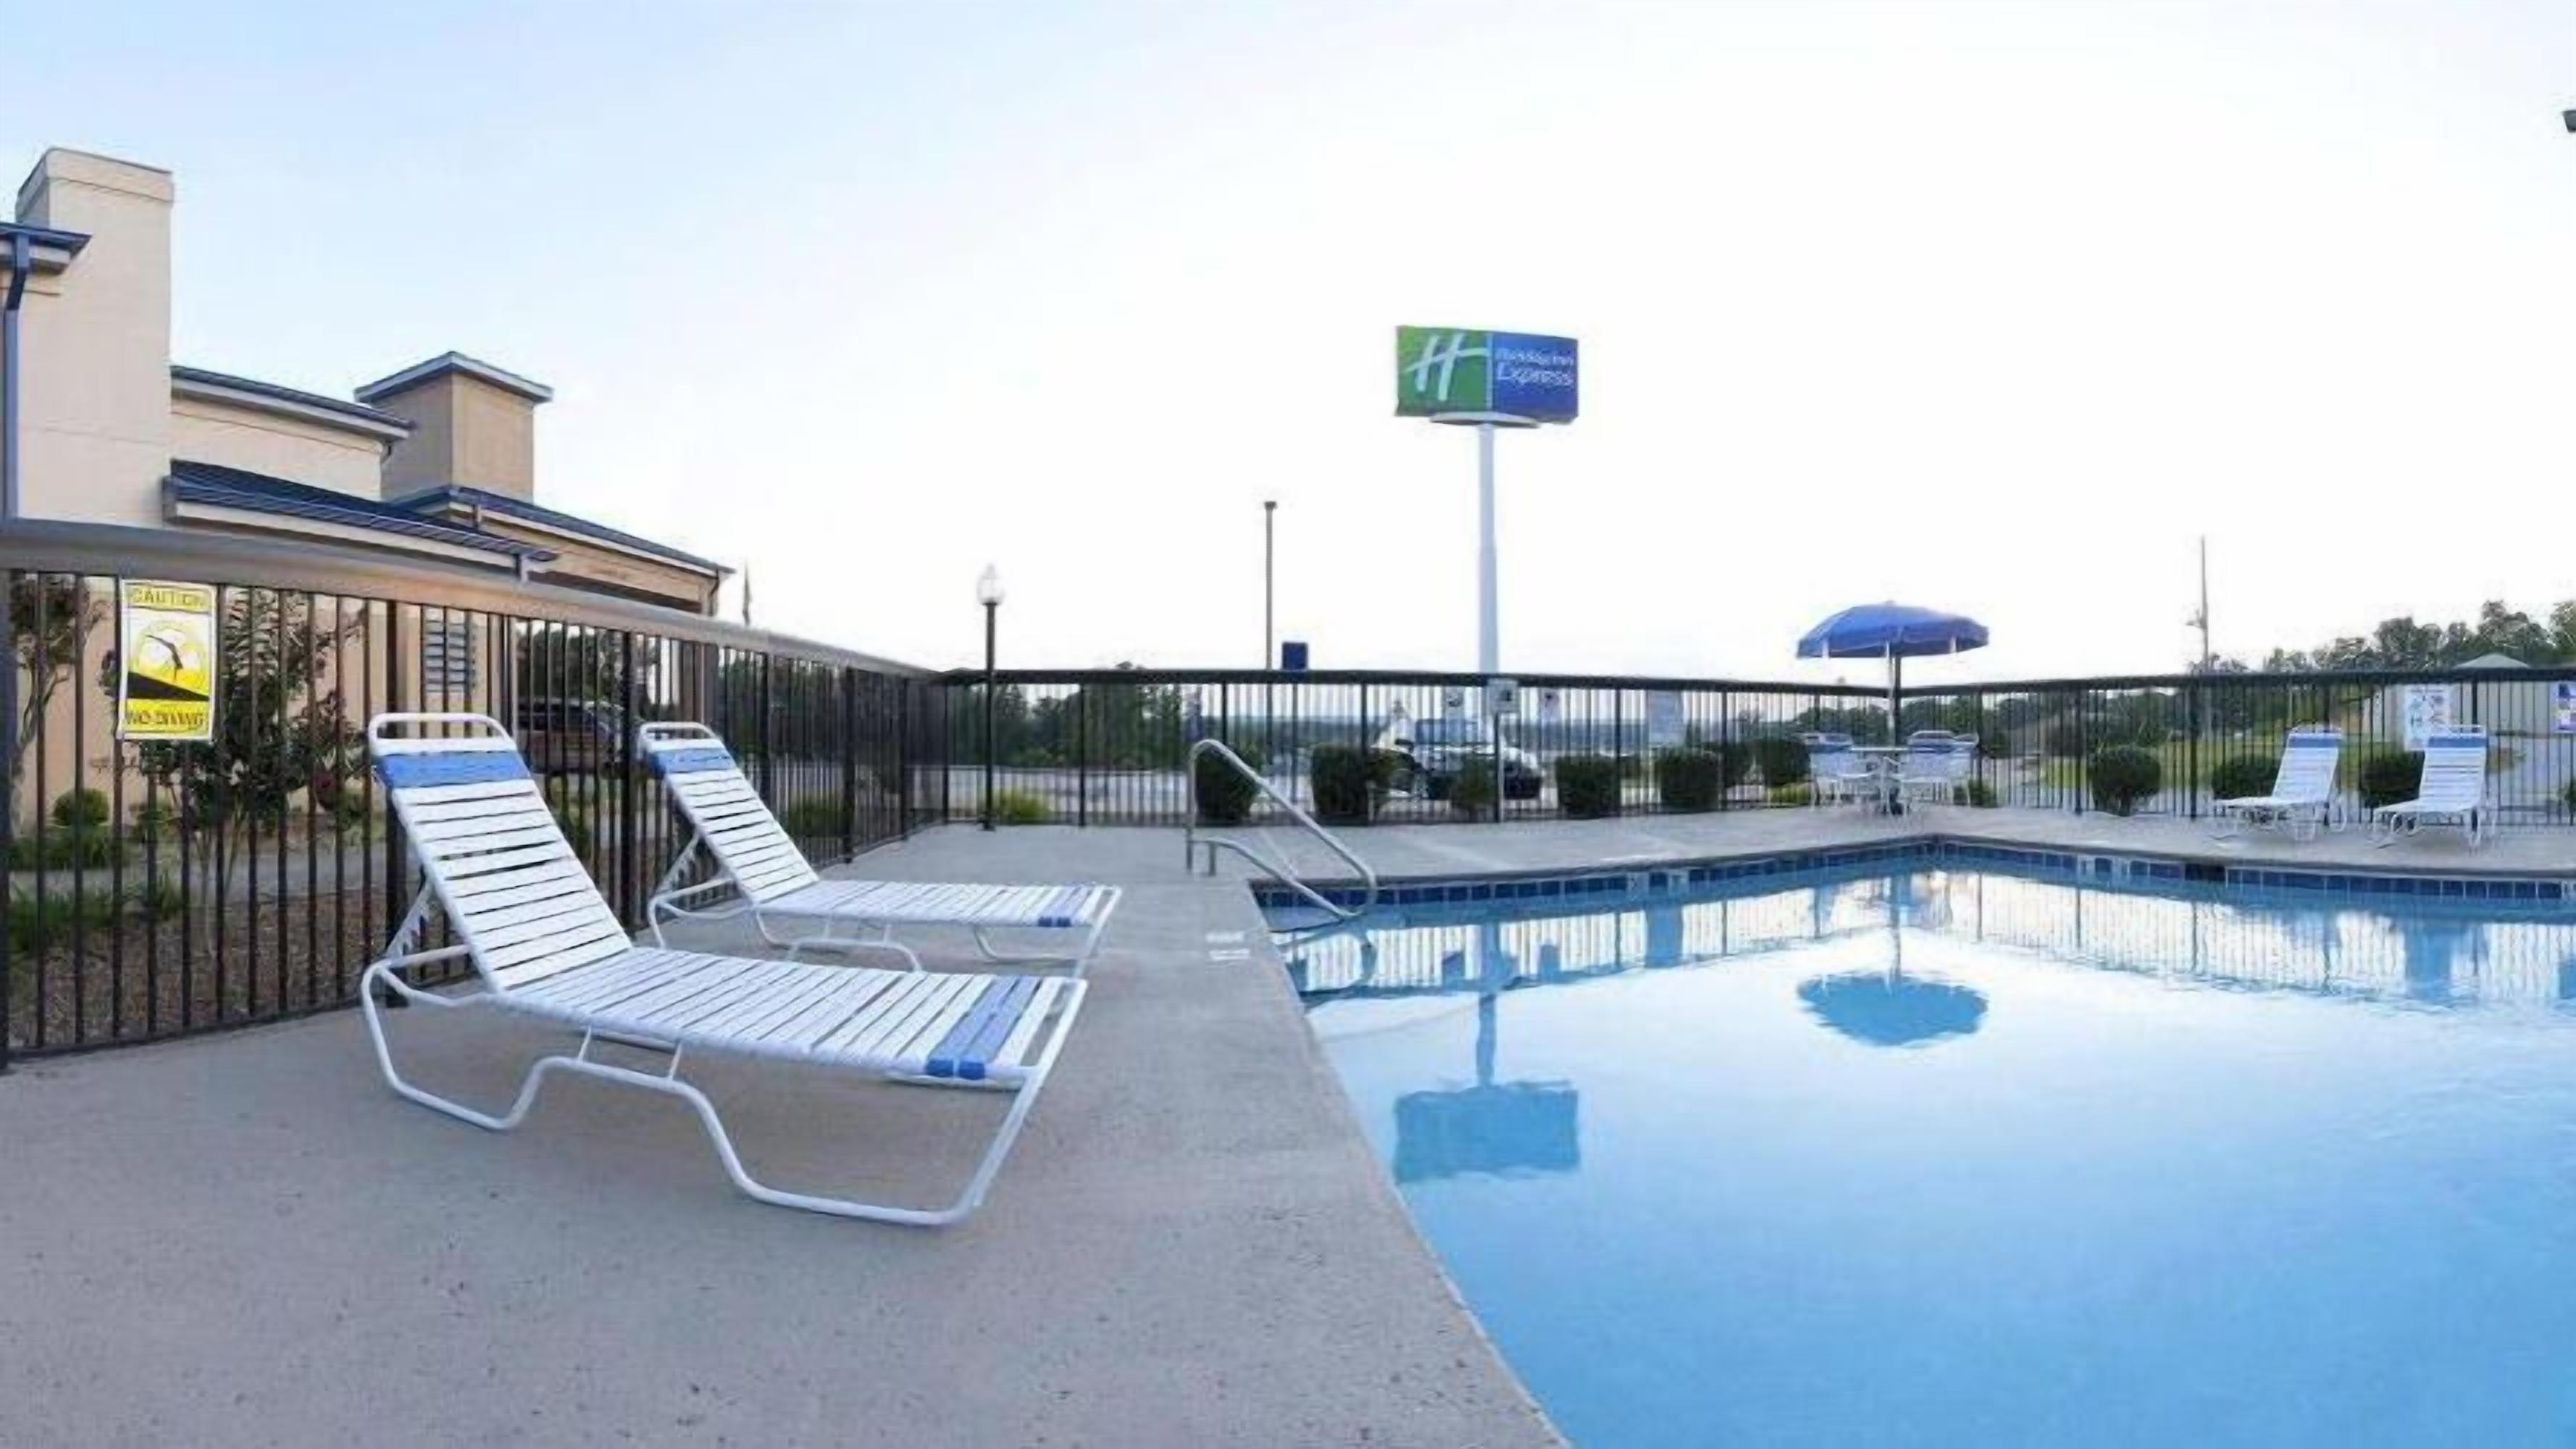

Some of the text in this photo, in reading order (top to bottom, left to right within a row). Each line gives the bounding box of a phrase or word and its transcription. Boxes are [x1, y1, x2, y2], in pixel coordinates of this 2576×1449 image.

[1497, 362, 1574, 387] Express
[131, 587, 208, 607] CAUTION
[127, 710, 151, 724] NO
